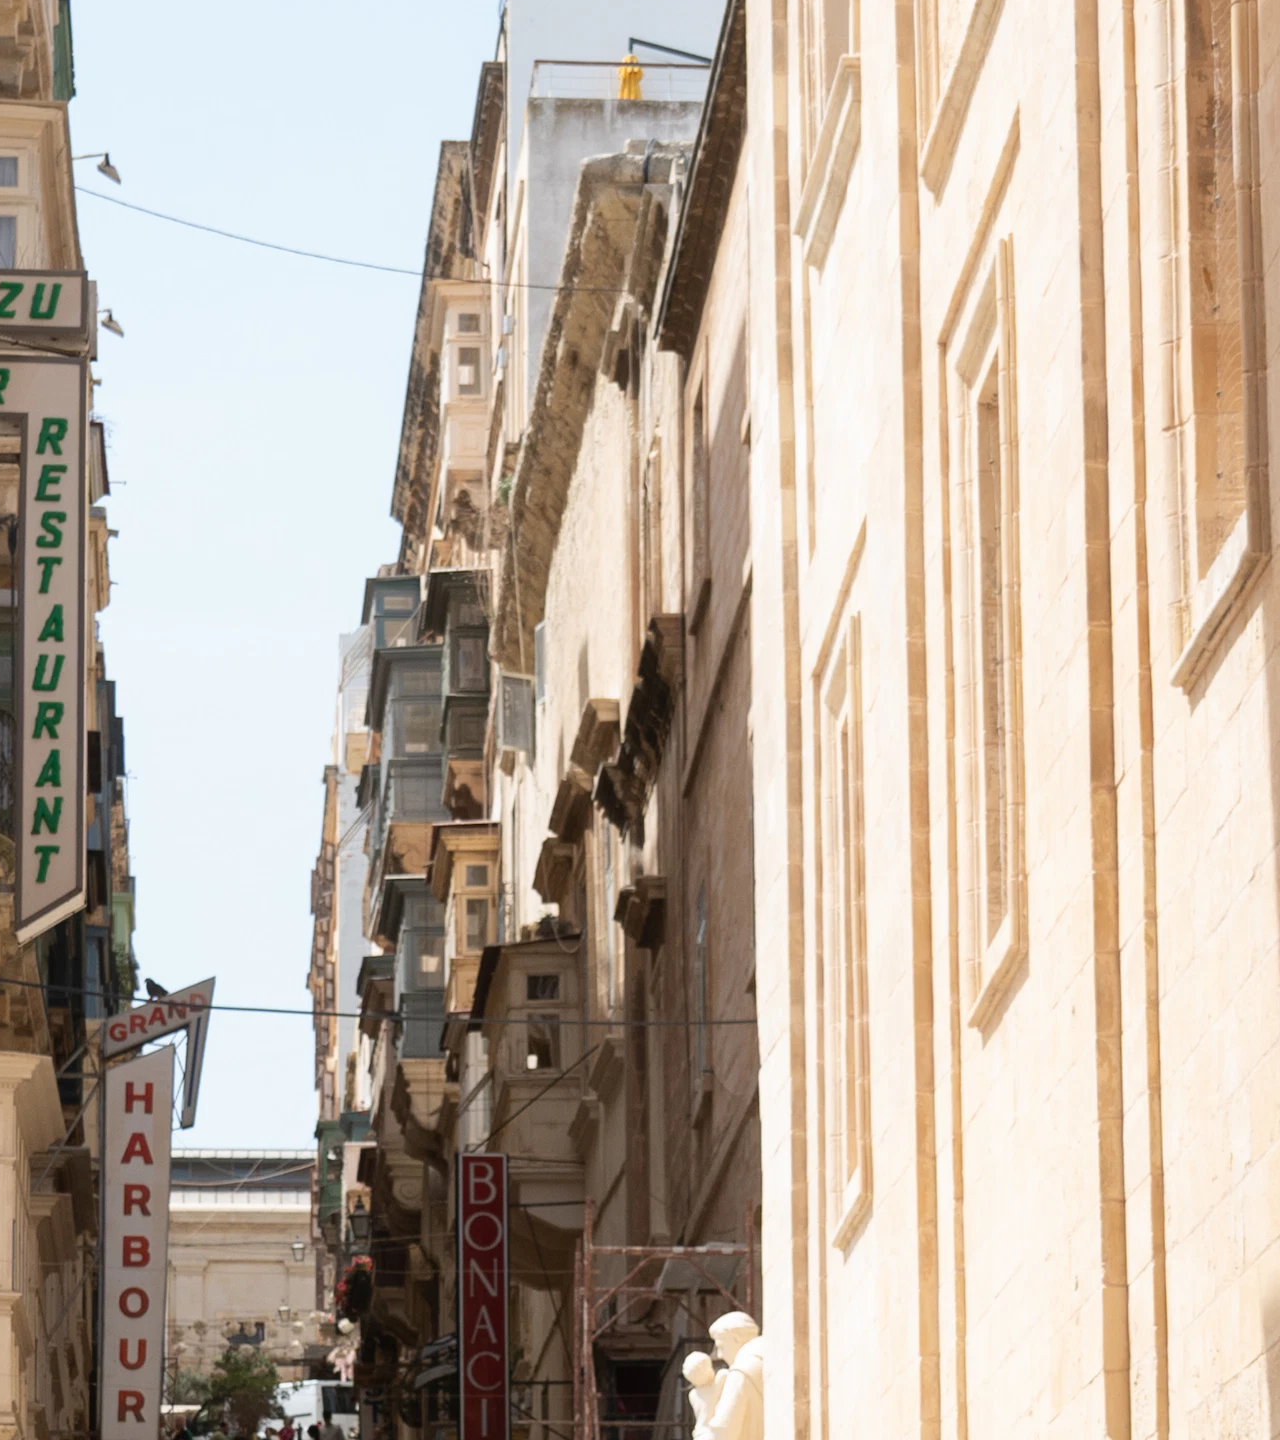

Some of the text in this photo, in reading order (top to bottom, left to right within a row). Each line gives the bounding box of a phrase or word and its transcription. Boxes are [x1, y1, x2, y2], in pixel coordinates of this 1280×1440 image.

[31, 417, 67, 883] RESTAURANT
[108, 992, 207, 1043] GRAND
[117, 1081, 154, 1423] HARBOUR
[464, 1161, 502, 1437] BONACI
